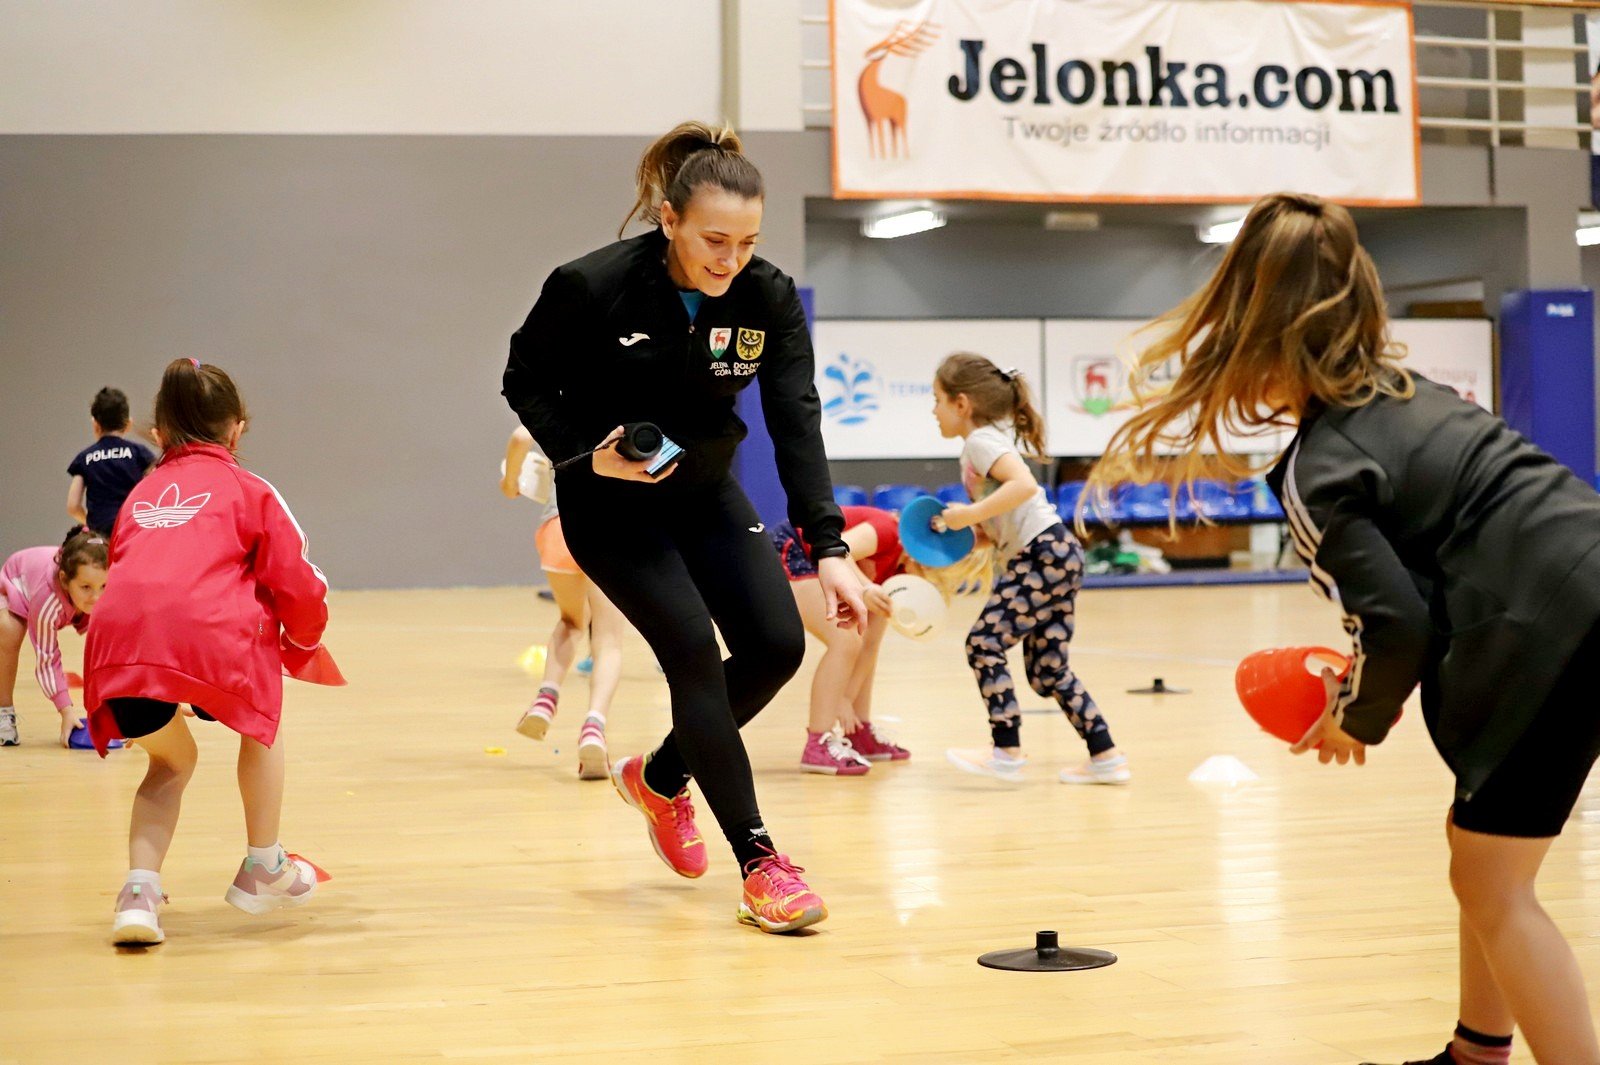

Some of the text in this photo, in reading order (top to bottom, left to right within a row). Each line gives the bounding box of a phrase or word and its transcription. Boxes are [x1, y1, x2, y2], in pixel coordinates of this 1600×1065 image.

[948, 39, 1399, 115] Jelonka.com
[1004, 117, 1089, 147] Twoje
[1195, 123, 1331, 150] informacji
[85, 447, 133, 465] POLICJA
